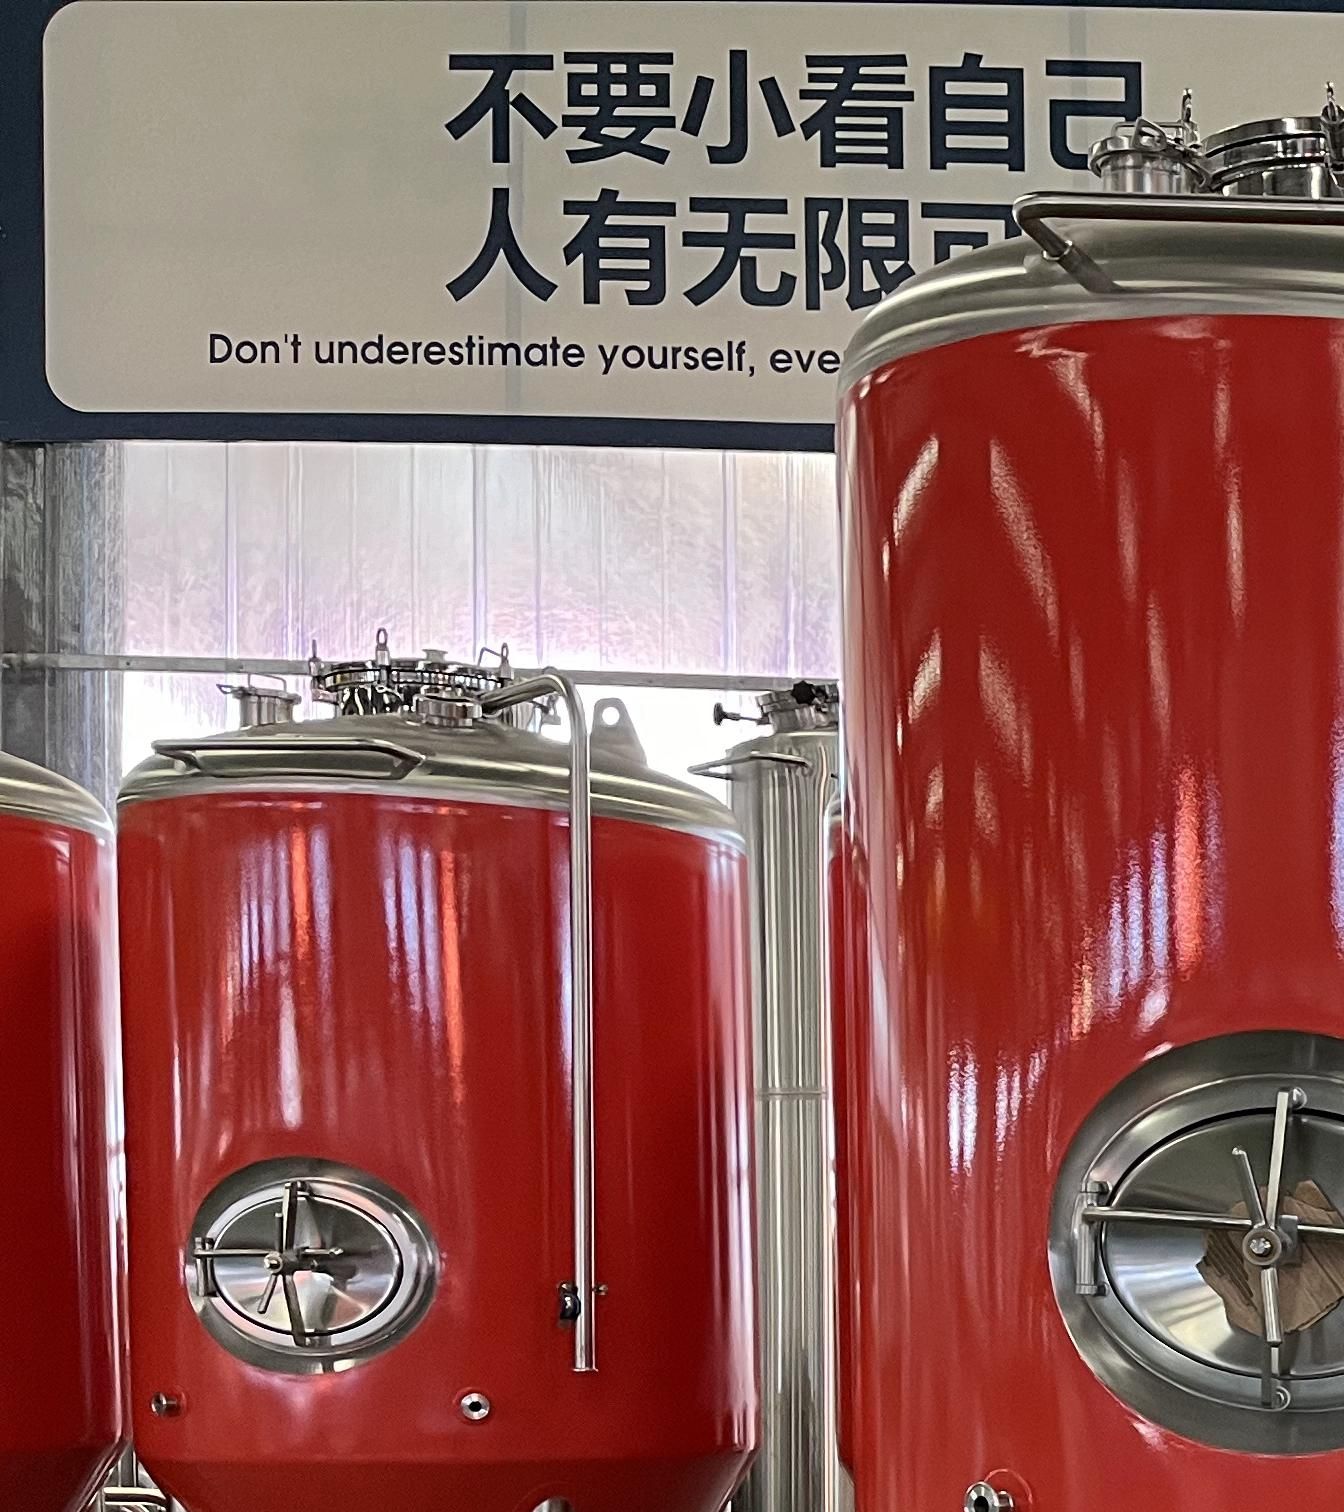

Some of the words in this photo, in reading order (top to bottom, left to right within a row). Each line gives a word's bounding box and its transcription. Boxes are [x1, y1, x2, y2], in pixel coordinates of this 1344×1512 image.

[445, 50, 1143, 173] 不要小看自己
[209, 333, 302, 365] Don't
[314, 333, 586, 368] underestimate
[597, 340, 756, 378] yourself,
